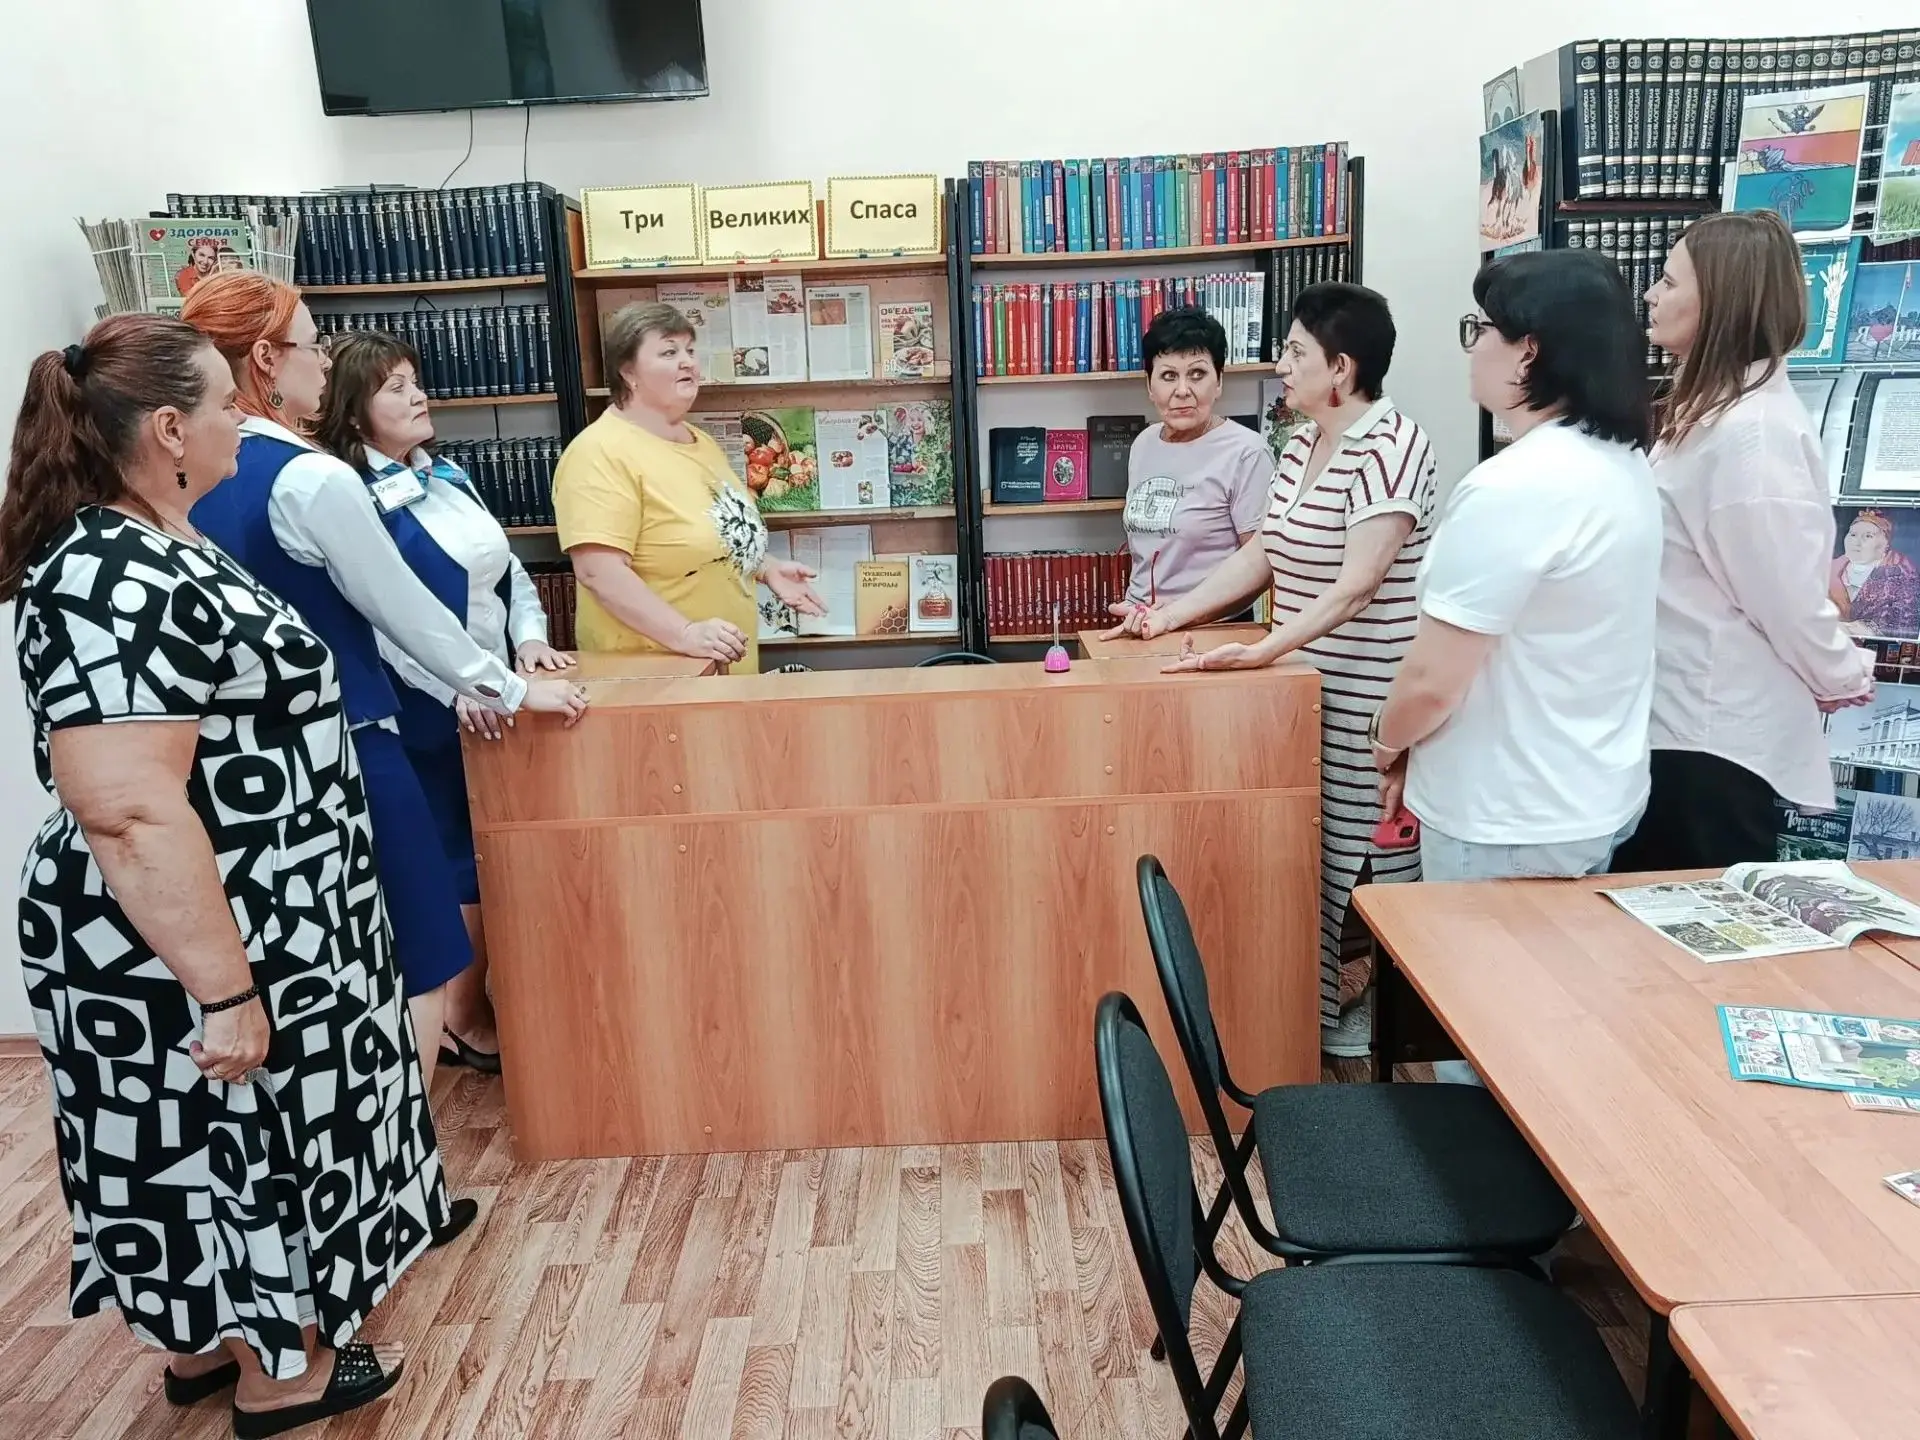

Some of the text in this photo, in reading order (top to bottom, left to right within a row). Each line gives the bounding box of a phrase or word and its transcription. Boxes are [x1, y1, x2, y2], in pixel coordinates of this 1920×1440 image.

[620, 200, 917, 233] Три Великих Спаса
[170, 228, 239, 238] ЗДОРОВАЯ
